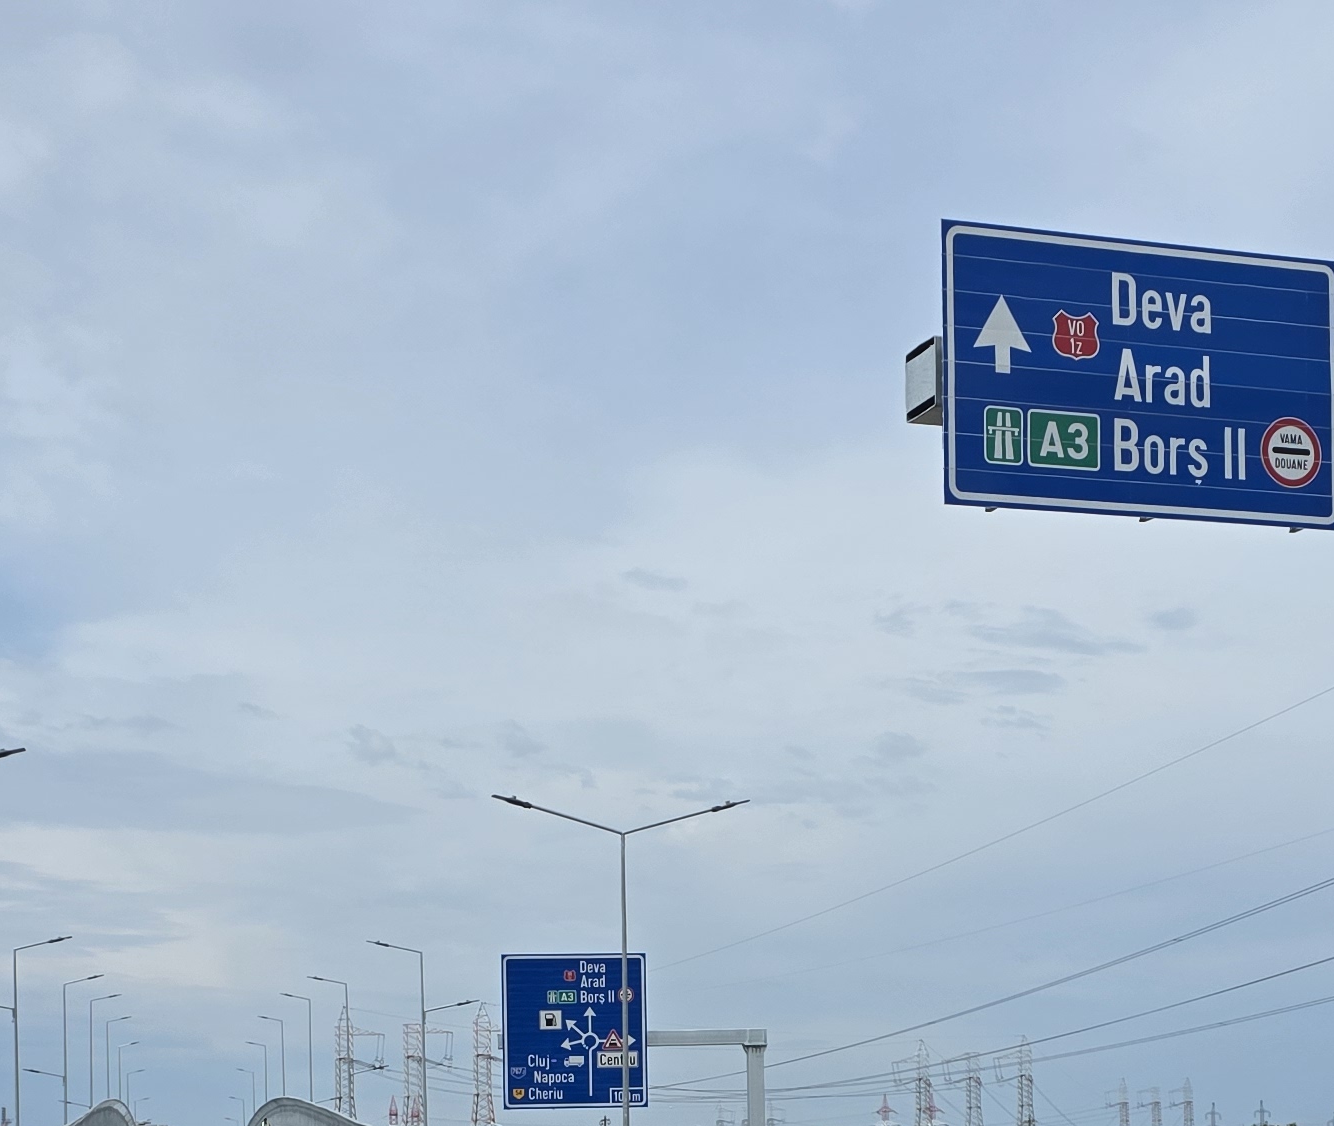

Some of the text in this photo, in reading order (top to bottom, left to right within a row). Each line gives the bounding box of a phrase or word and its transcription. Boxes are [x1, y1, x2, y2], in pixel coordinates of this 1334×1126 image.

[1111, 272, 1212, 334] Deva
[1113, 348, 1211, 408] Arad
[1279, 433, 1303, 446] VAMA
[1039, 418, 1246, 486] A3 Borș II
[1274, 457, 1309, 471] DOUANE
[579, 960, 606, 974] Deva
[580, 975, 606, 988] Arad
[560, 992, 574, 1002] A3
[580, 990, 605, 1005] Borș
[608, 990, 615, 1003] II
[527, 1054, 557, 1070] Cluj-
[599, 1053, 636, 1066] Centu
[533, 1071, 575, 1086] Napoca
[528, 1087, 564, 1100] Cheriu
[614, 1090, 631, 1102] 10
